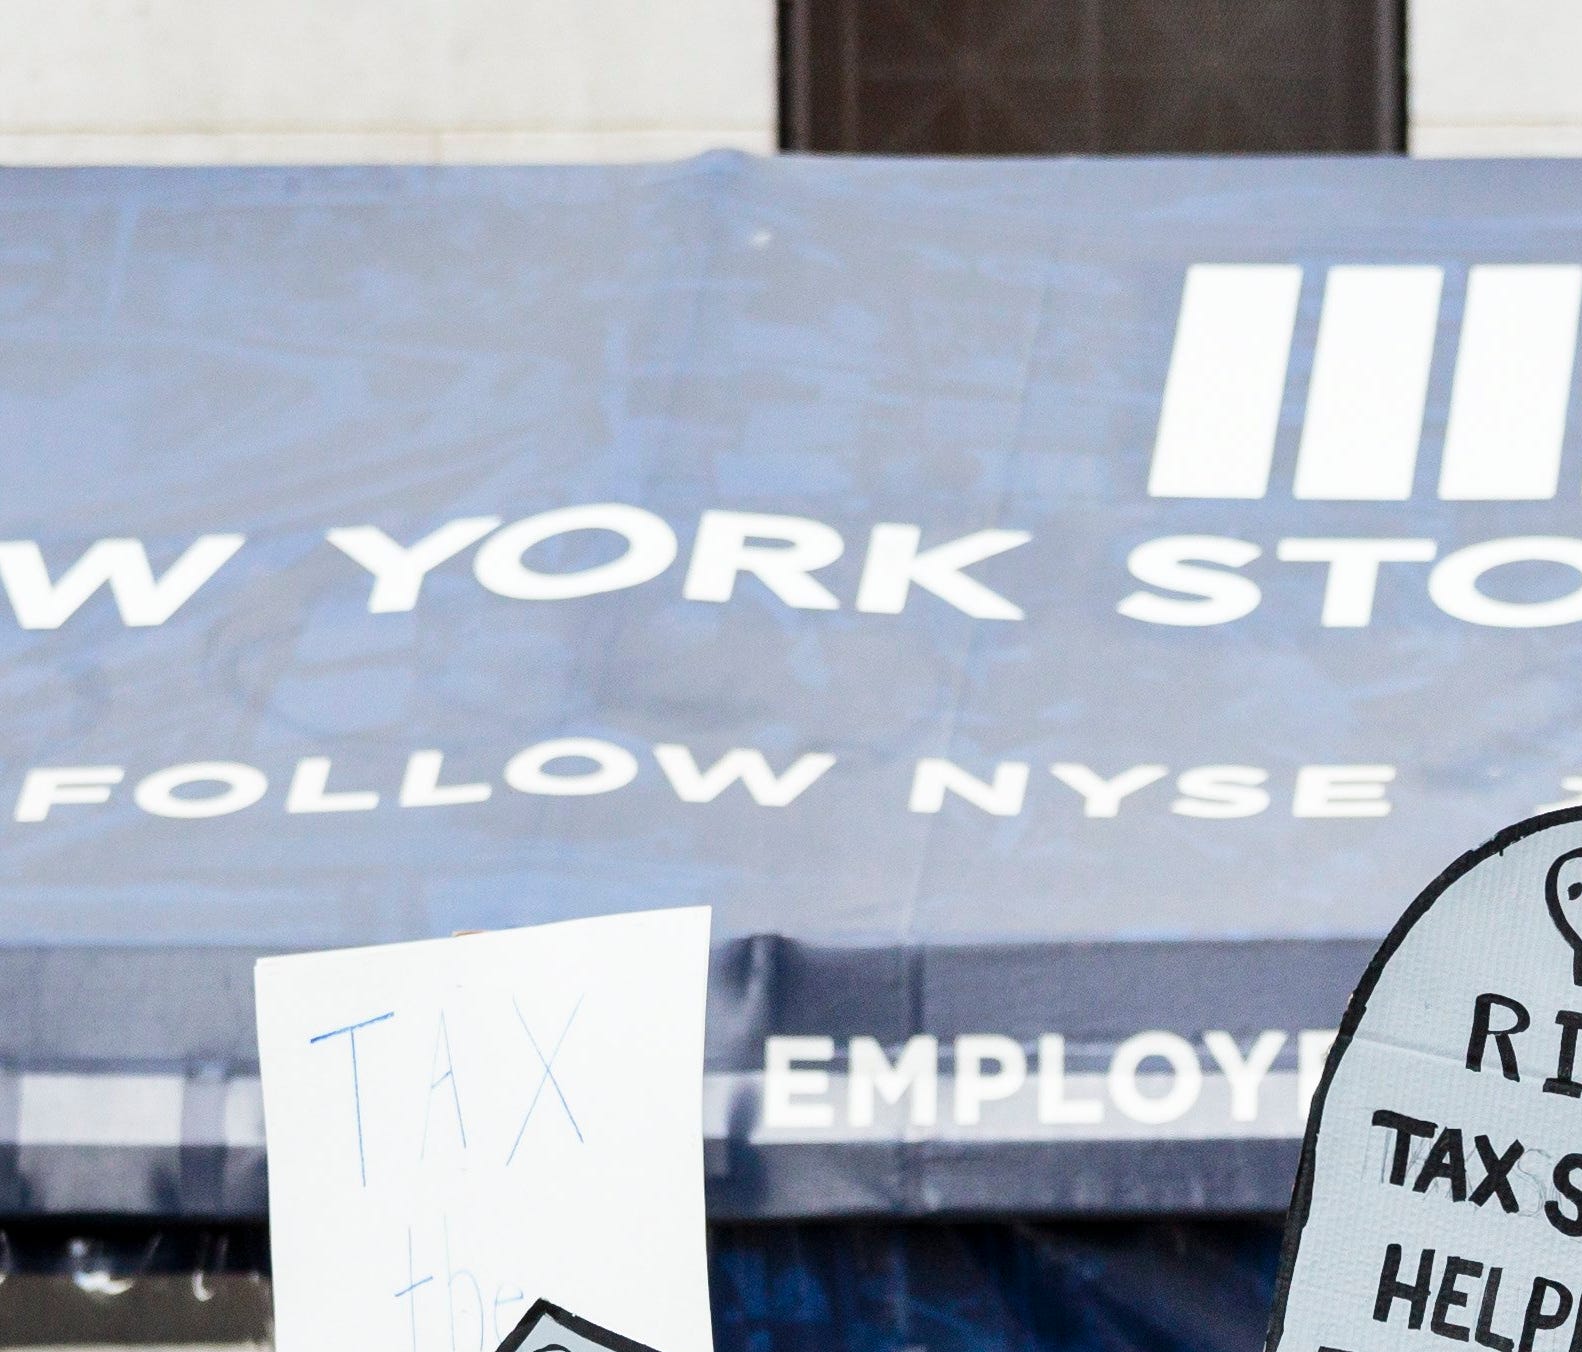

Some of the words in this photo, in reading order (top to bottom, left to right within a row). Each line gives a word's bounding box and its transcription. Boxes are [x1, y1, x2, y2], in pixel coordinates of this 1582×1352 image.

[326, 502, 1033, 621] YORK
[15, 737, 837, 823] FOLLOW
[908, 759, 1397, 820] NYSE
[310, 992, 585, 1188] TAX
[1371, 1109, 1525, 1214] TAX
